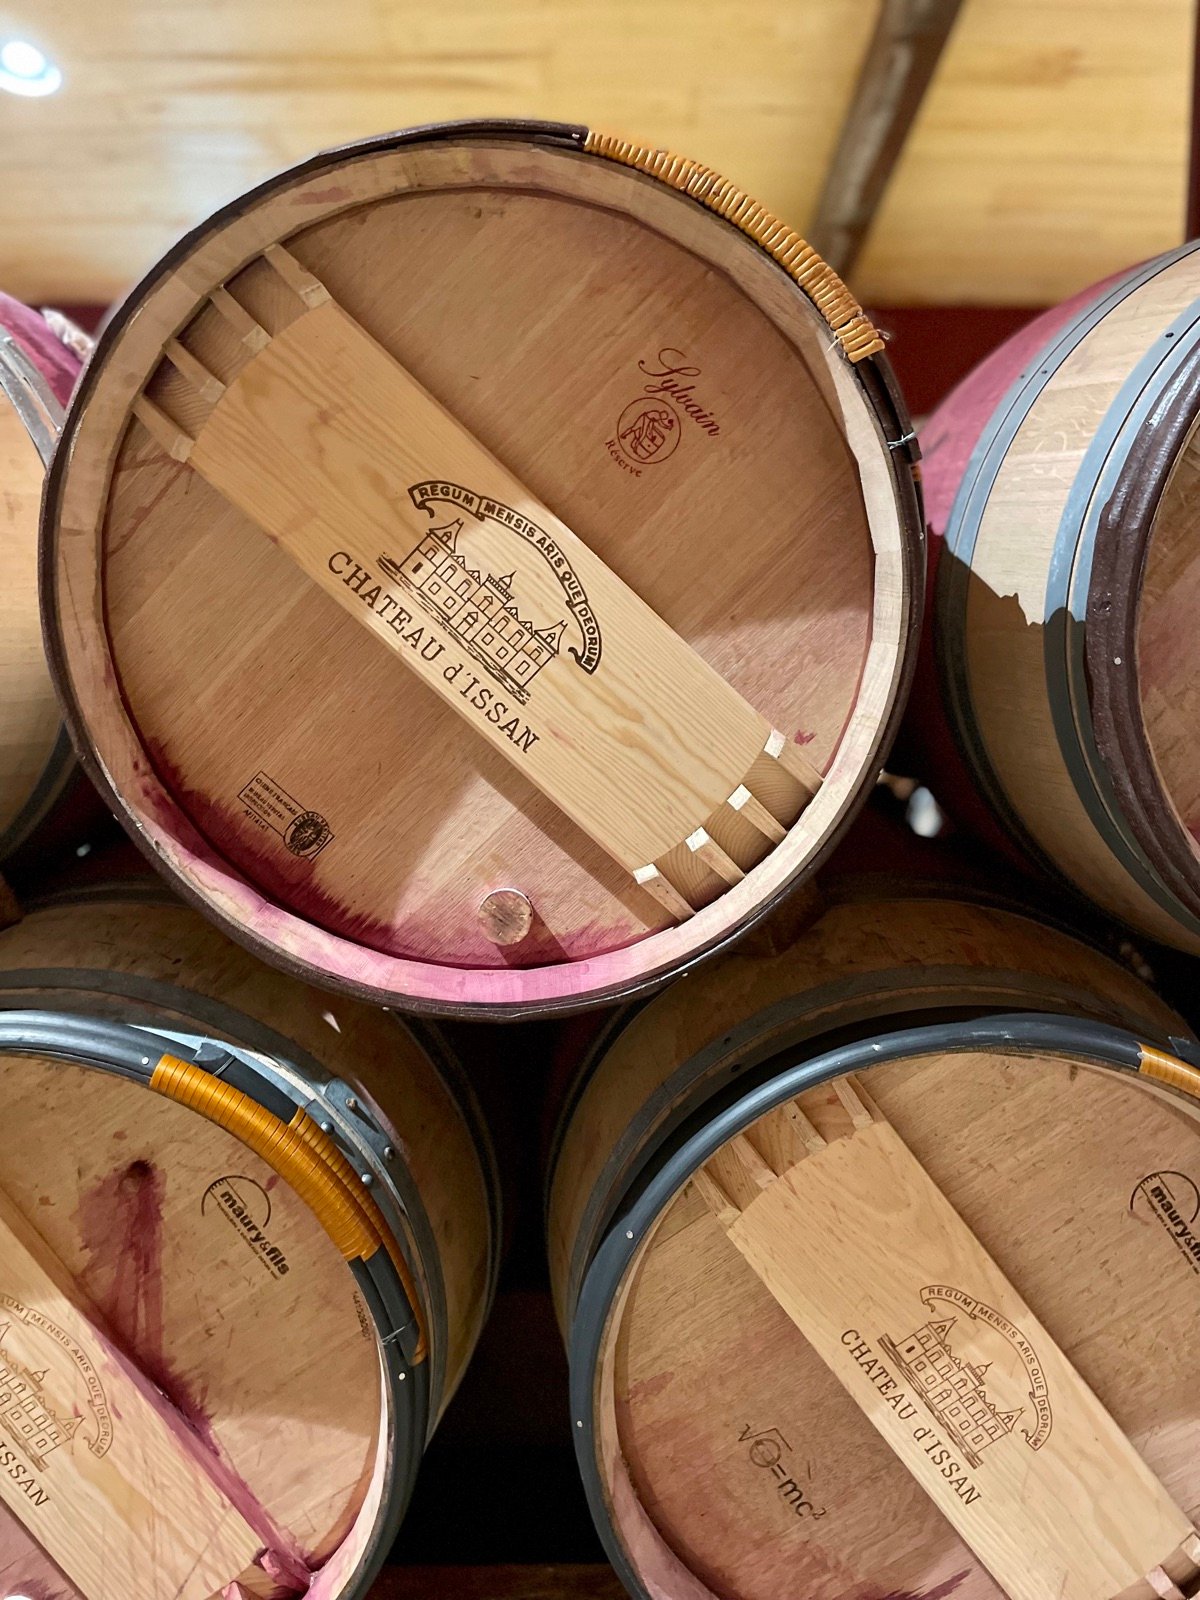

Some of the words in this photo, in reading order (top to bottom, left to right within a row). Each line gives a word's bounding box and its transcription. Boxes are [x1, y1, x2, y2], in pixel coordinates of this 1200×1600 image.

[638, 348, 720, 436] Sylvain
[418, 484, 475, 507] REGUM
[483, 502, 536, 538] MENSIS
[536, 534, 566, 573] ARIS
[560, 571, 583, 602] QUE
[577, 606, 599, 668] DEORUM
[327, 551, 447, 662] CHATEAU
[442, 663, 540, 753] d'ISSAN
[220, 1191, 290, 1276] maury&fils
[928, 1288, 972, 1308] REGUM
[31, 1313, 71, 1346] MENSIS
[977, 1306, 1018, 1339] MENSIS
[71, 1348, 90, 1373] ARIS
[1017, 1340, 1036, 1369] ARIS
[88, 1376, 103, 1399] QUE
[1031, 1368, 1045, 1392] QUE
[95, 1403, 111, 1454] DEORUM
[840, 1329, 918, 1420] CHATEAU
[912, 1426, 982, 1506] d'ISSAN
[1031, 1398, 1050, 1447] DEORUM
